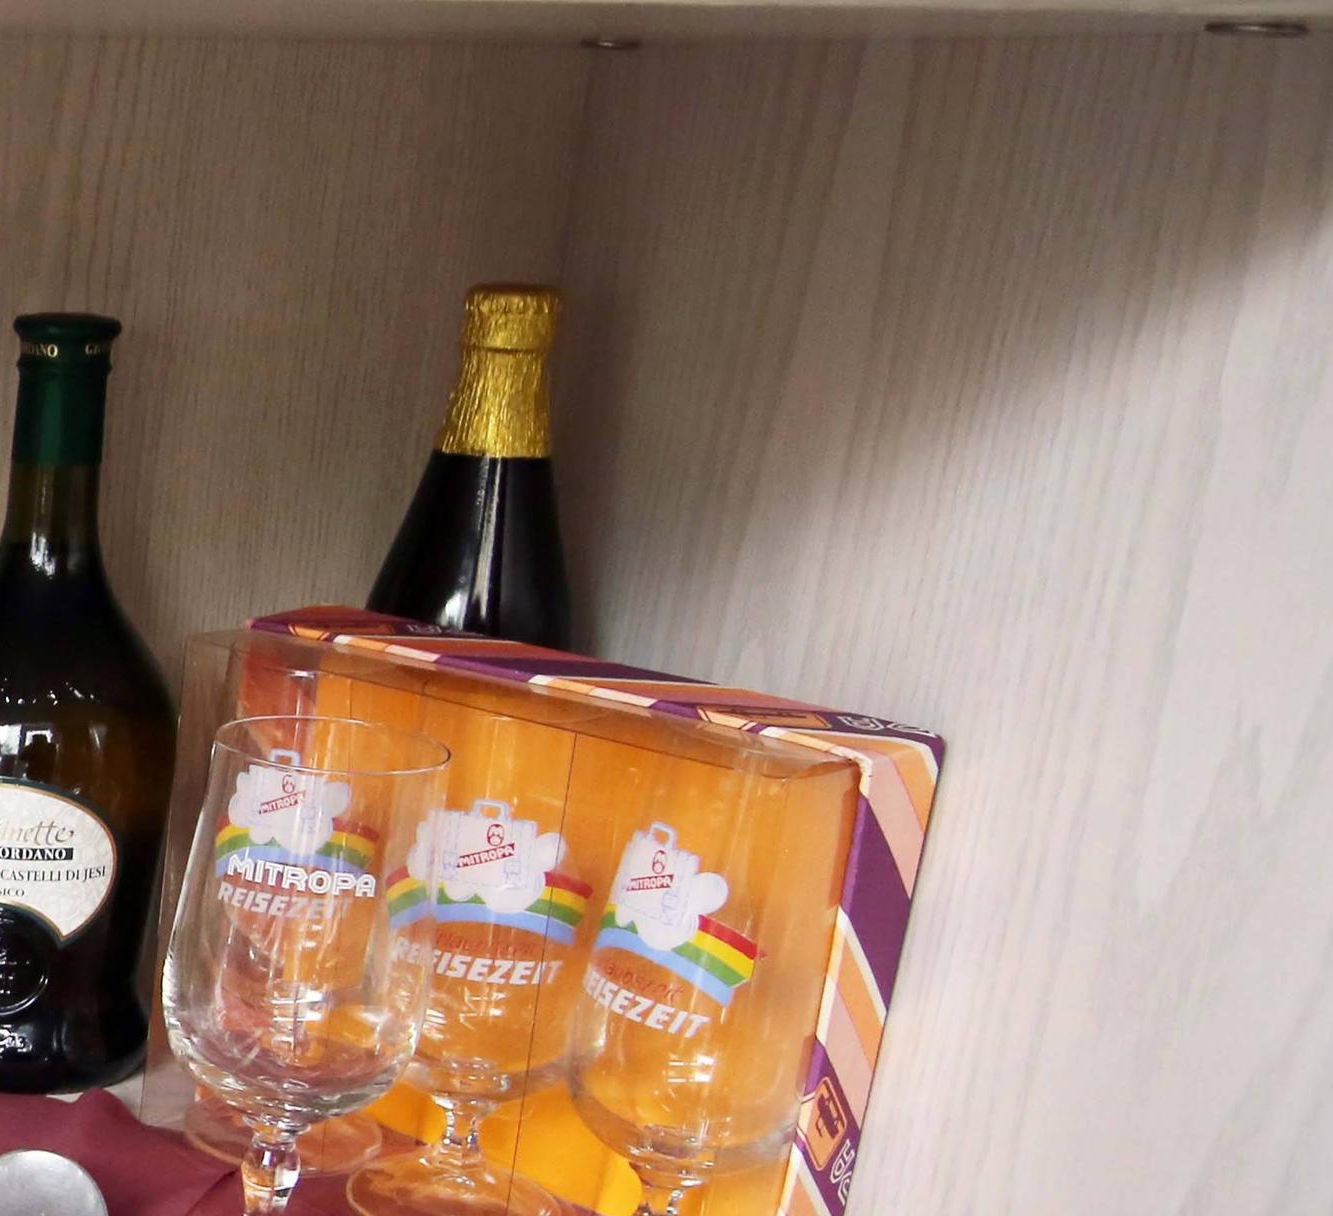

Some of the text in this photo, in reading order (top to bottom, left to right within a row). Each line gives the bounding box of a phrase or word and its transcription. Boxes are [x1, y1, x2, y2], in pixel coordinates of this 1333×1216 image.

[459, 845, 514, 867] MITROPA
[0, 868, 61, 882] CASTELLI
[65, 868, 80, 881] DI
[82, 865, 106, 881] JESI
[227, 854, 376, 898] MITROPA
[218, 881, 351, 919] REISEZE
